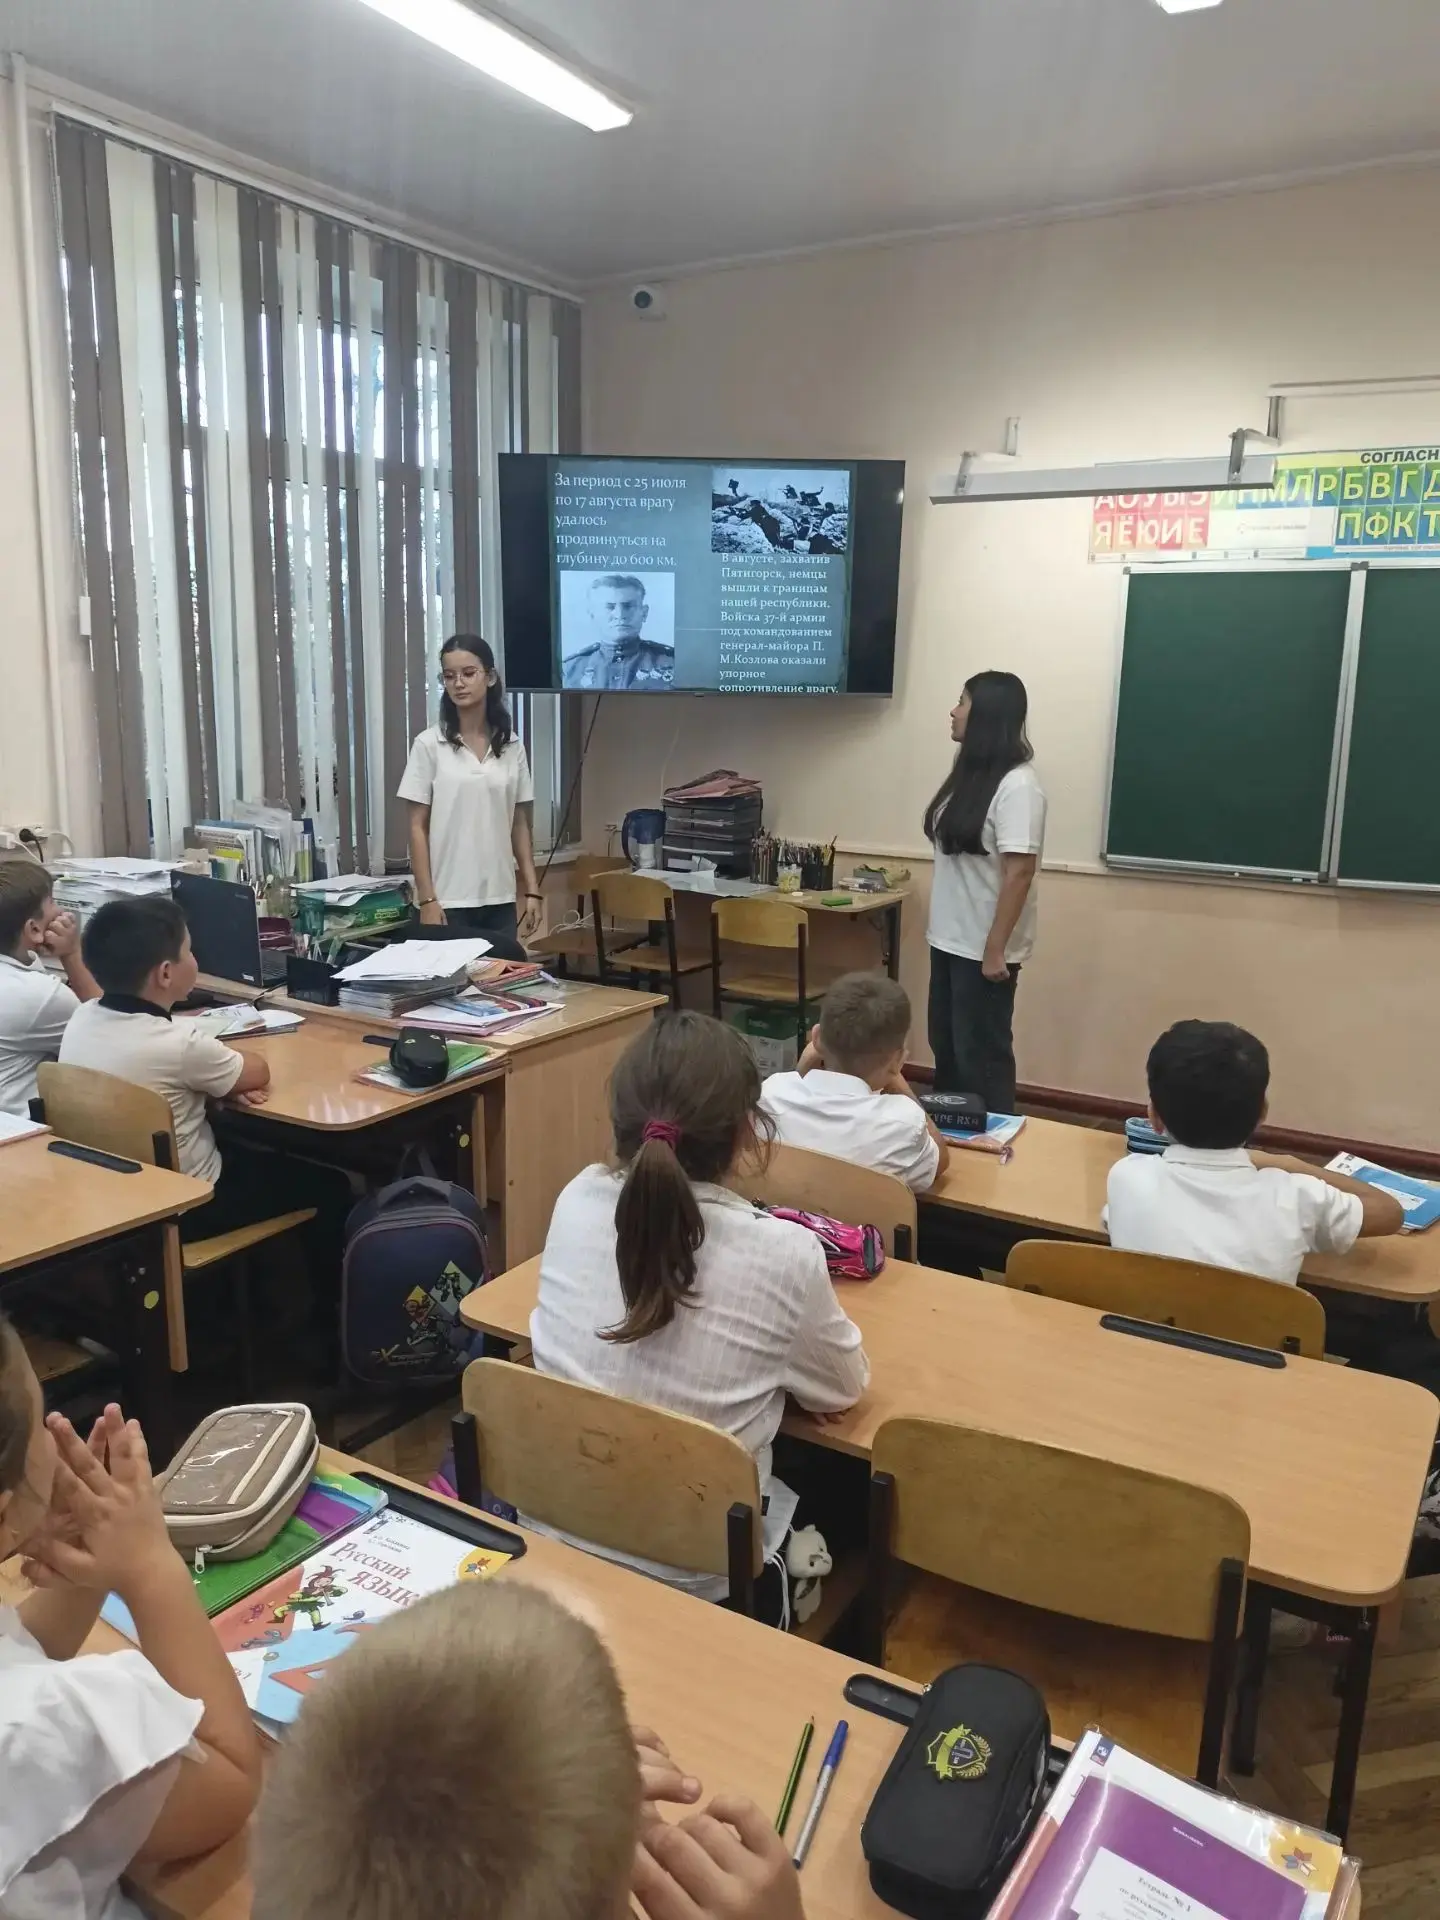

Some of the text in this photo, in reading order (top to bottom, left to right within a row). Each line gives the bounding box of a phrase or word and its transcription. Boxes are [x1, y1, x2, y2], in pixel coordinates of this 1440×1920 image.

[555, 473, 687, 490] За период с 25 июля
[555, 496, 675, 512] по 17 августа врагу
[555, 515, 607, 528] удалось
[556, 534, 666, 549] продвинуться на
[556, 552, 677, 567] глубину до 600 км.
[722, 553, 831, 566] В августе, захватив
[721, 567, 827, 580] Пятигорск, немцы
[721, 584, 760, 592] вышли
[773, 585, 828, 595] границам
[721, 598, 831, 610] нашей республики.
[721, 611, 826, 624] Войска 37-й армии
[720, 628, 832, 638] под командованием
[720, 641, 825, 653] генерал-майора П.
[781, 657, 826, 665] оказали
[720, 670, 766, 680] упорное
[719, 684, 839, 694] сопротивление врагу.
[330, 1542, 412, 1581] Русский
